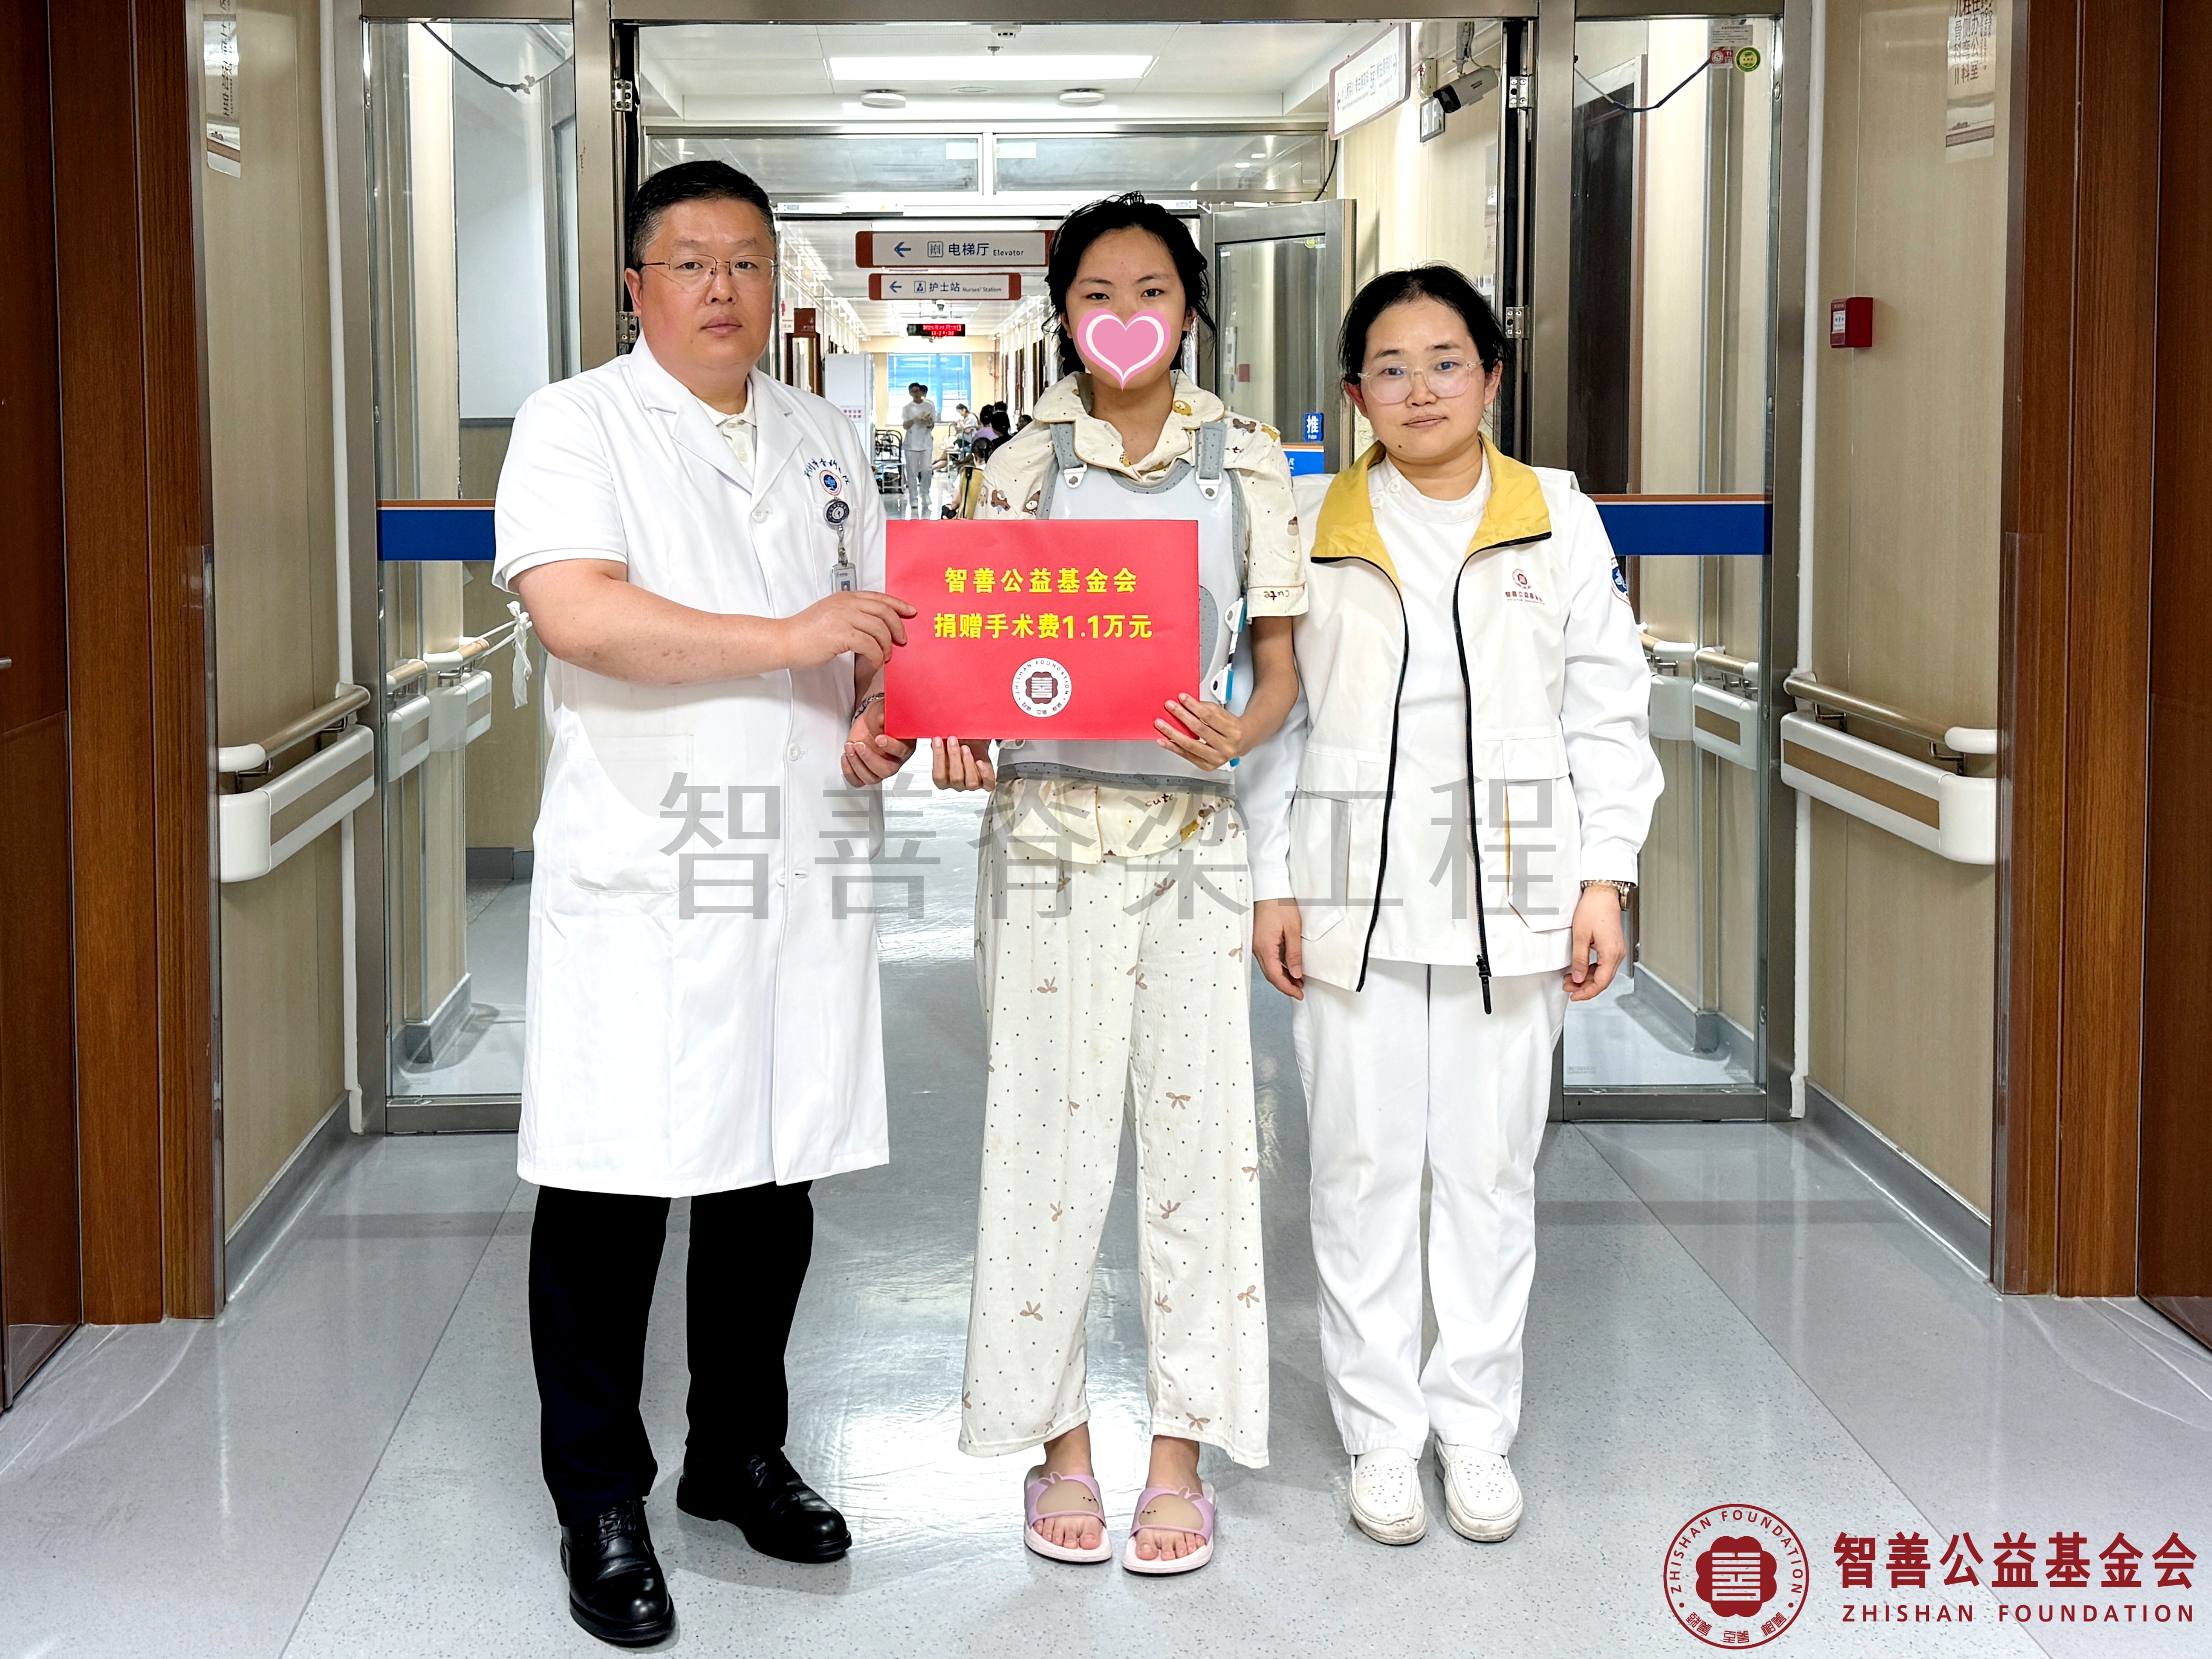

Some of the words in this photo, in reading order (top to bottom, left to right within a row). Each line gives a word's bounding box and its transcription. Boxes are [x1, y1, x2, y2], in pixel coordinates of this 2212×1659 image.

[948, 242, 989, 256] 电梯厅
[929, 282, 960, 292] 护士站
[1306, 415, 1319, 433] 推
[945, 568, 1136, 593] 智善公益基金会
[934, 614, 1152, 638] 捐赠手术费1.1万元
